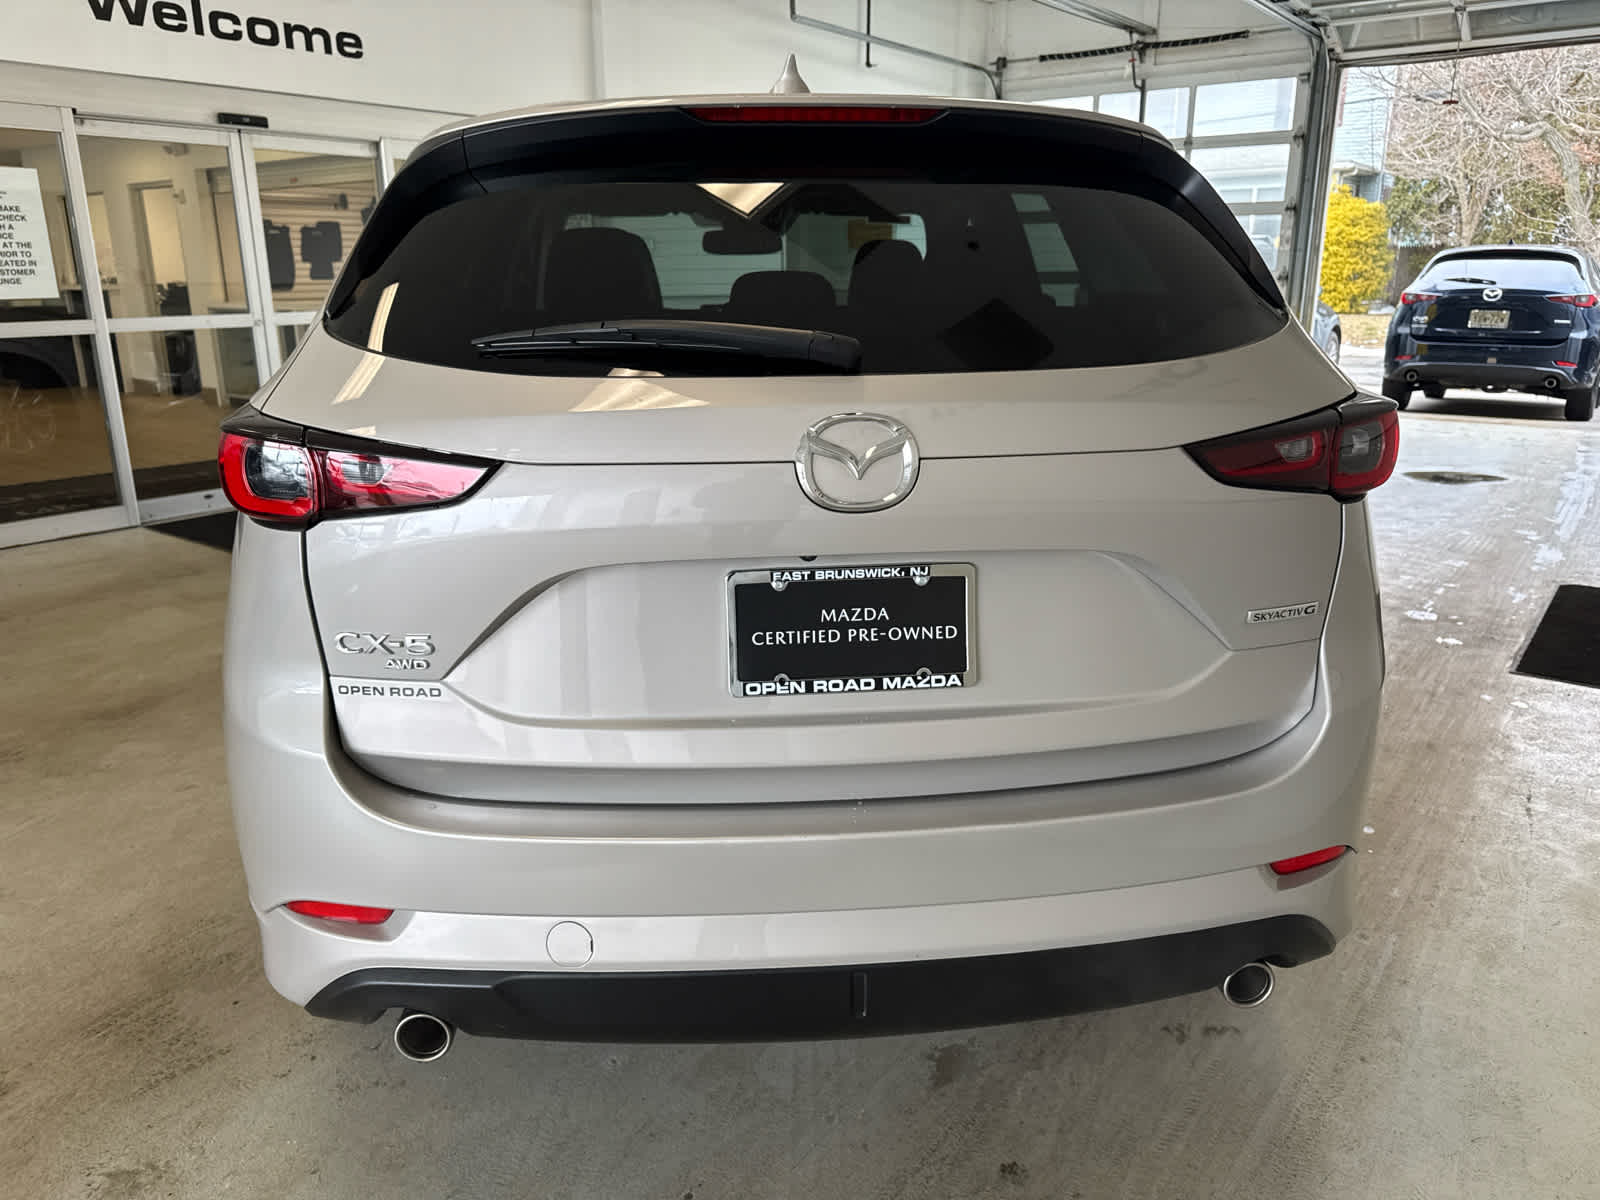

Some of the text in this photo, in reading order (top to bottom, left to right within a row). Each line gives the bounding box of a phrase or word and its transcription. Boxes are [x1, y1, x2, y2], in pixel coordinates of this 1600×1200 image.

[15, 241, 32, 249] THE
[20, 250, 32, 258] TO
[28, 259, 37, 267] IN
[772, 566, 929, 582] EAST BRUNSWICK, NJ
[820, 607, 890, 623] MAZDA
[751, 625, 958, 646] CERTIFIED PRE-OWNED
[334, 631, 436, 656] CX-5
[383, 658, 431, 670] AWD
[337, 684, 442, 698] OPEN ROAD
[745, 674, 962, 696] OPEN ROAD MAZDA
